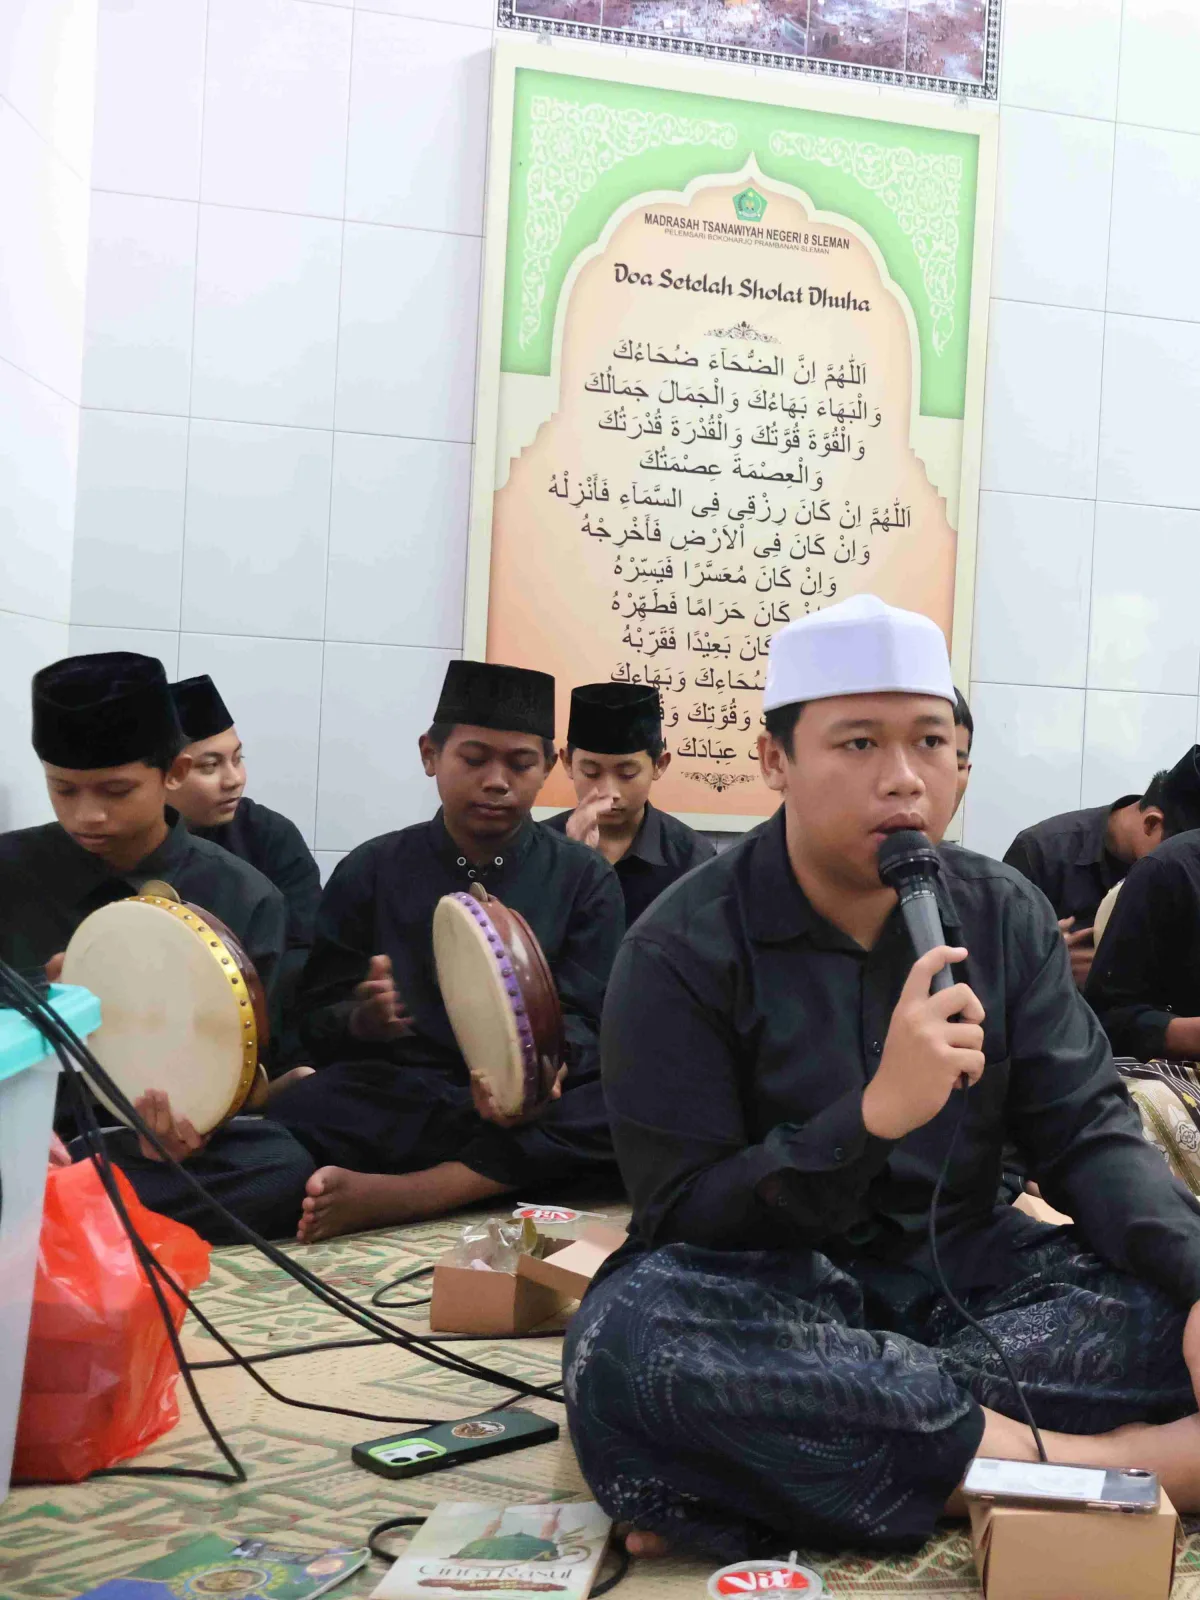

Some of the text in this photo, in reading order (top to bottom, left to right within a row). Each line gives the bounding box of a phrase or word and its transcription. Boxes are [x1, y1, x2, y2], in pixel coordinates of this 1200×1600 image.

[644, 212, 850, 250] MADRASAH TSANAWIYAH NEGERI 8 SLEMAN
[664, 228, 706, 240] PELEMSARI
[754, 239, 800, 251] PRAMBANAN
[801, 244, 830, 255] SLEMAN
[614, 262, 871, 312] Doa Setelah Sholat Dhuha
[724, 1571, 793, 1591] Vit
